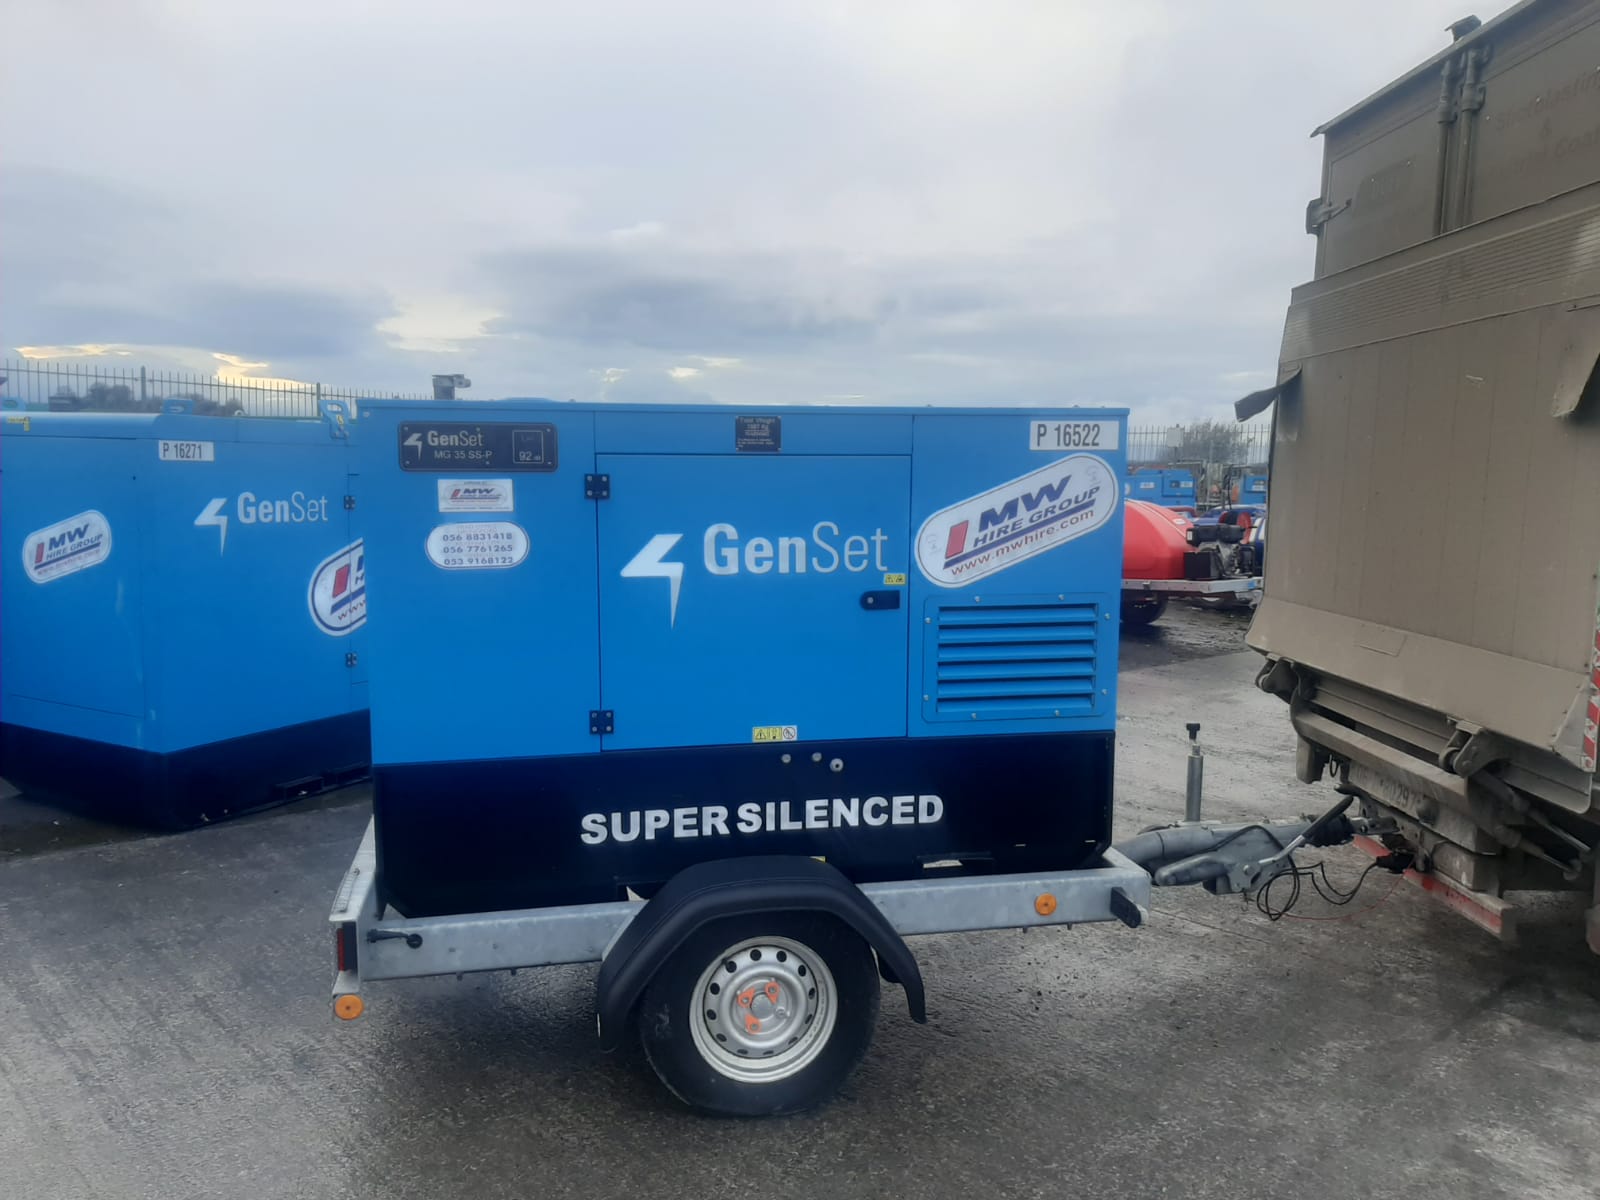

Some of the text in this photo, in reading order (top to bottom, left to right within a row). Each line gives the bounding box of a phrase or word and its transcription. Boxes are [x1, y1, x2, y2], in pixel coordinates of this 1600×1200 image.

[427, 430, 484, 447] GenSet
[1036, 423, 1100, 447] P 16522
[162, 441, 203, 460] P 16271
[434, 450, 493, 460] MG 35 SS-P
[237, 491, 328, 524] GenSet
[973, 486, 1100, 548] HIRE GROUP
[978, 474, 1072, 533] MW
[48, 523, 90, 551] MW
[442, 533, 463, 541] 056
[443, 546, 463, 554] 056
[703, 521, 889, 576] GenSet
[951, 509, 1094, 576] www.mwhire.com
[580, 794, 945, 846] SUPER SILENCED
